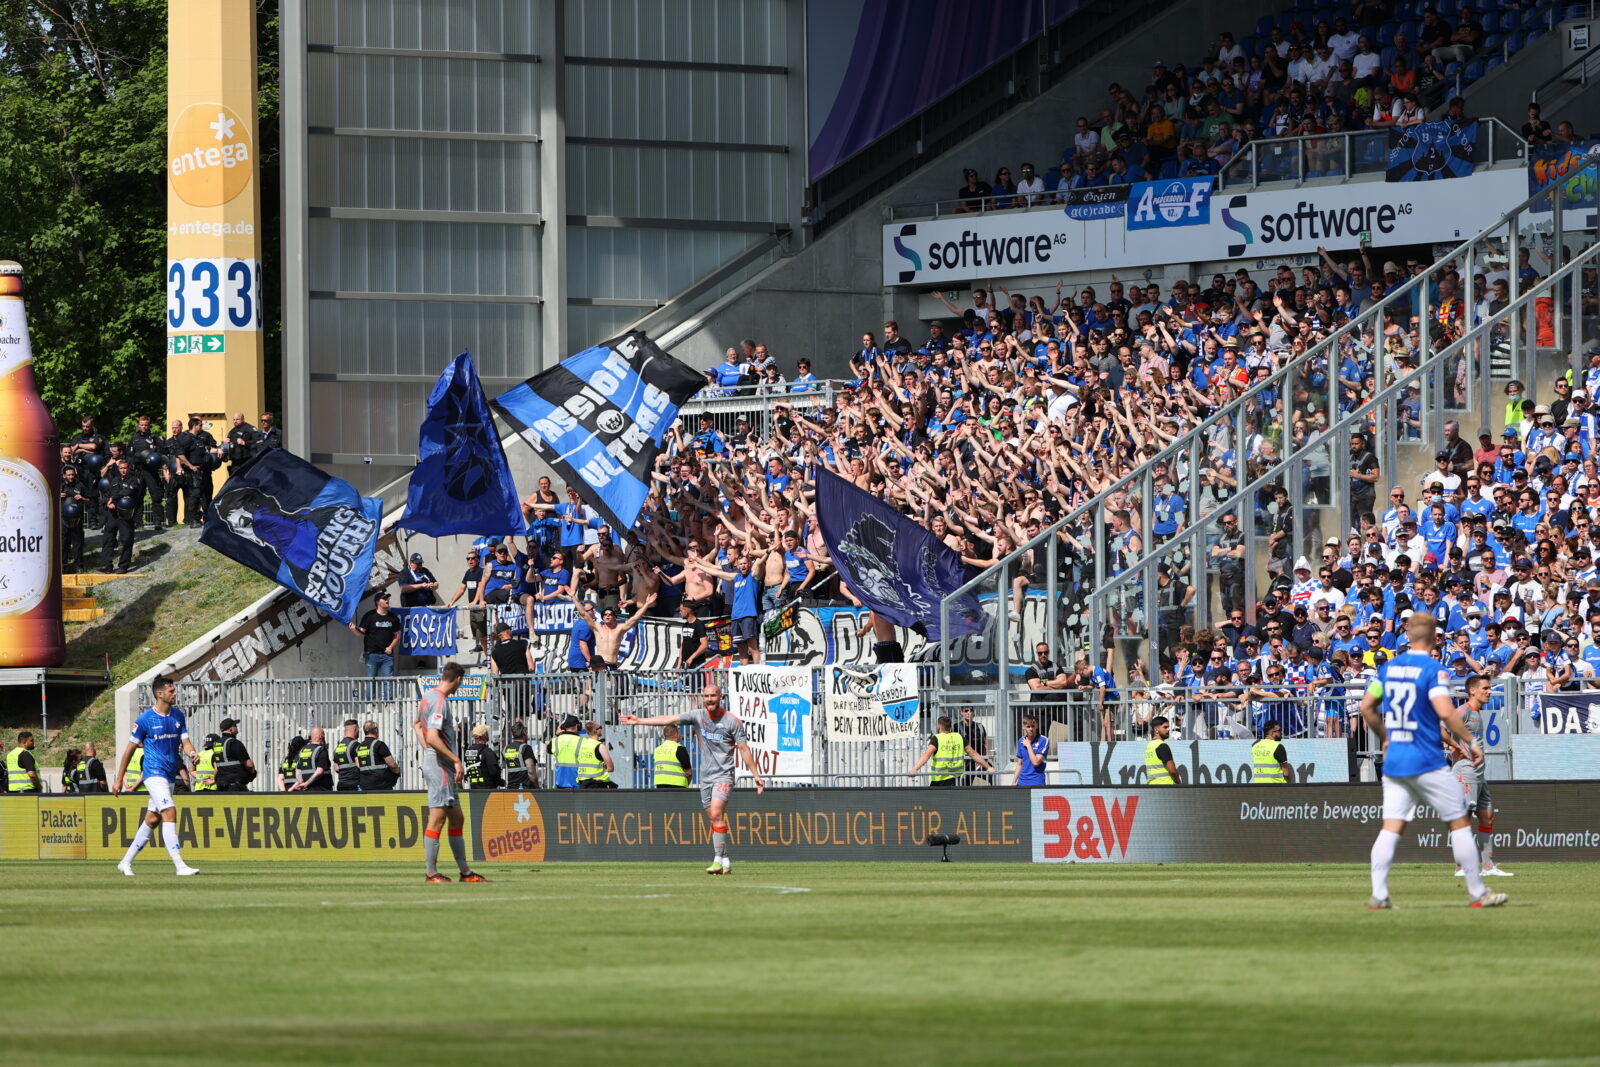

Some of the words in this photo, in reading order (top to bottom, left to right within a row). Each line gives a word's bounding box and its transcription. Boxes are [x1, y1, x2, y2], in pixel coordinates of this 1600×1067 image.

[171, 142, 249, 177] entega
[1083, 191, 1116, 202] Gegen
[1134, 187, 1156, 221] A
[1188, 182, 1211, 217] F
[180, 221, 254, 236] entega.de
[1260, 201, 1396, 243] software
[1398, 203, 1413, 215] AG
[928, 230, 1052, 270] software
[1053, 233, 1067, 245] AG
[0, 334, 21, 345] acher
[520, 335, 639, 453] PASSIONE
[579, 382, 671, 488] ULTRAS
[305, 506, 355, 602] STRIVING
[320, 517, 376, 614] YOUTH
[398, 613, 454, 649] ESSELN
[733, 671, 772, 694] TAUSCHE
[739, 696, 767, 719] PAPA
[894, 705, 905, 720] 07
[1384, 681, 1418, 730] 32
[741, 720, 765, 743] GEN
[782, 709, 798, 734] 10
[834, 717, 854, 733] DEIN
[856, 714, 888, 736] TRIKOT
[1485, 713, 1500, 746] 6
[734, 745, 780, 775] TRKOT
[41, 810, 83, 828] Plakat-
[556, 812, 653, 844] EINFACH
[897, 806, 942, 845] FÜR
[956, 810, 1021, 845] ALLE.
[1240, 802, 1318, 820] Dokumente
[41, 832, 83, 844] verkauft.de
[488, 825, 540, 857] entega
[1418, 829, 1441, 847] wir
[1516, 828, 1600, 847] Dokumente
